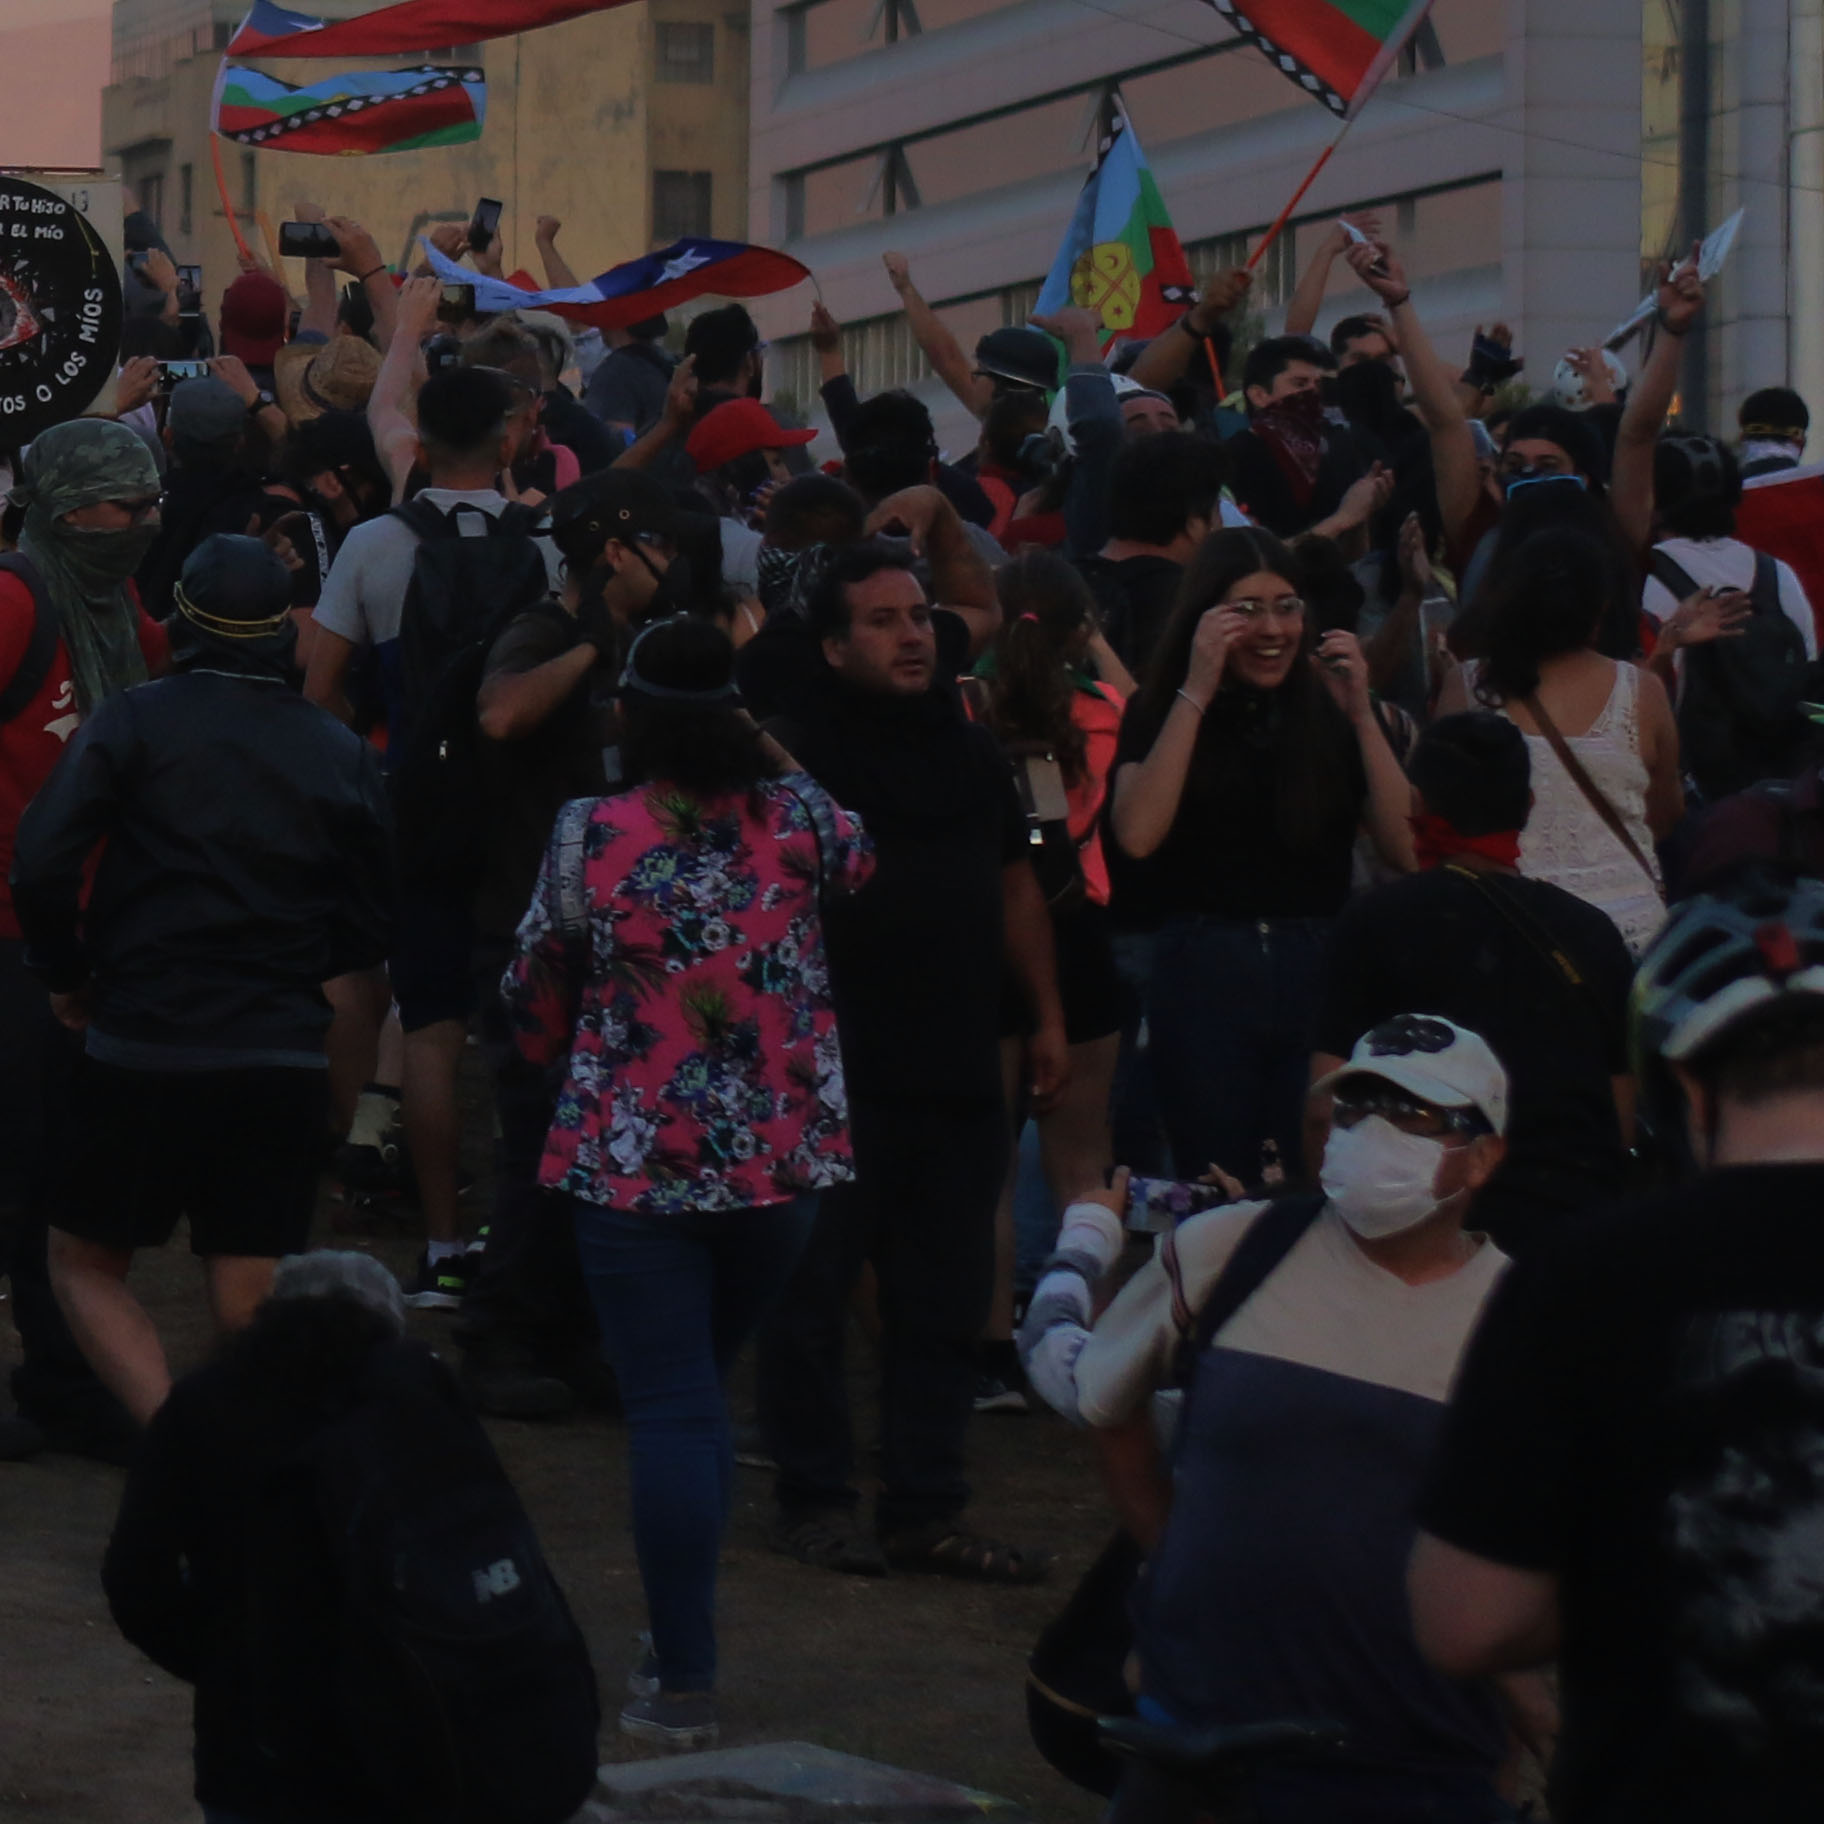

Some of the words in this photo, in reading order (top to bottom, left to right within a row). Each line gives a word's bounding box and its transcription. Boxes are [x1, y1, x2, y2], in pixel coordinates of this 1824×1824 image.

[11, 223, 28, 238] EL
[36, 384, 52, 403] O
[54, 351, 87, 386] LOS
[75, 288, 103, 344] MÍOS
